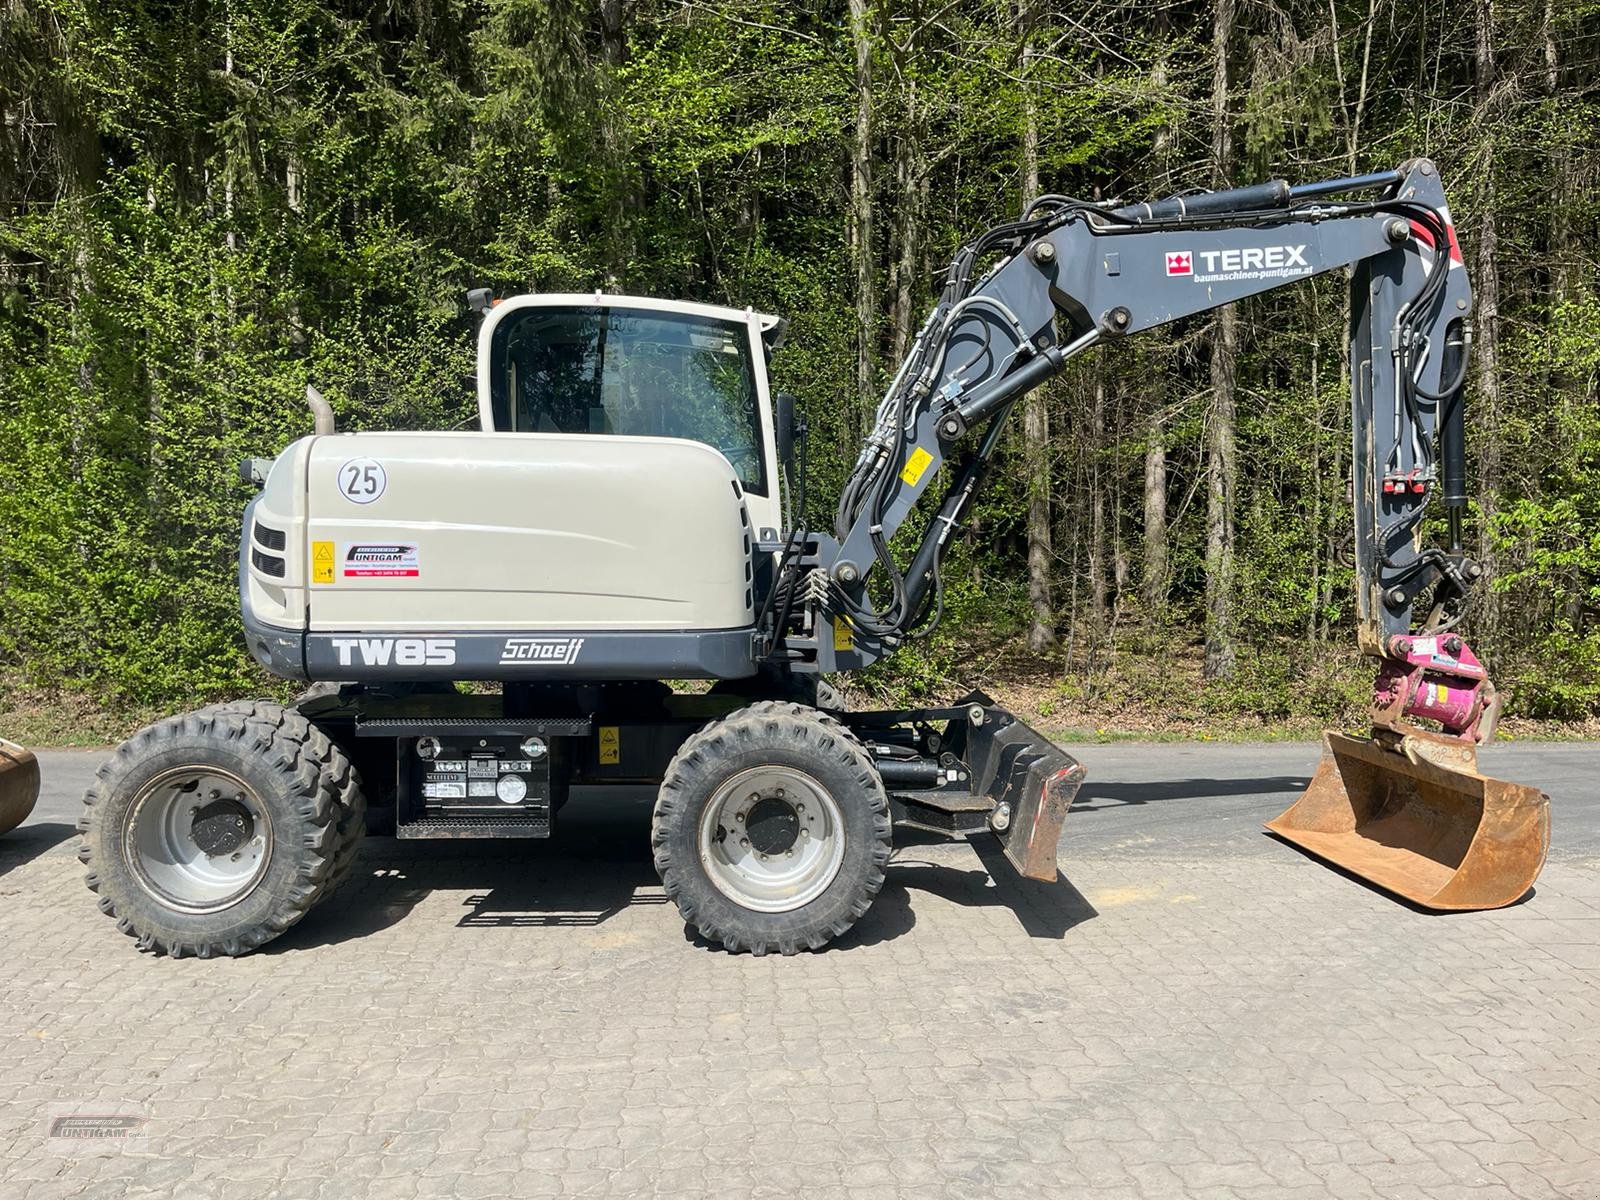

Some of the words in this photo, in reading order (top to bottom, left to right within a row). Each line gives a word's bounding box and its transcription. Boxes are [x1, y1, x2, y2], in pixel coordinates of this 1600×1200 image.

[1199, 244, 1308, 273] TEREX
[1194, 265, 1314, 284] baumaschinen-puntigam.at
[347, 465, 378, 495] 25
[332, 639, 456, 666] TW85
[499, 638, 584, 665] Schaeff
